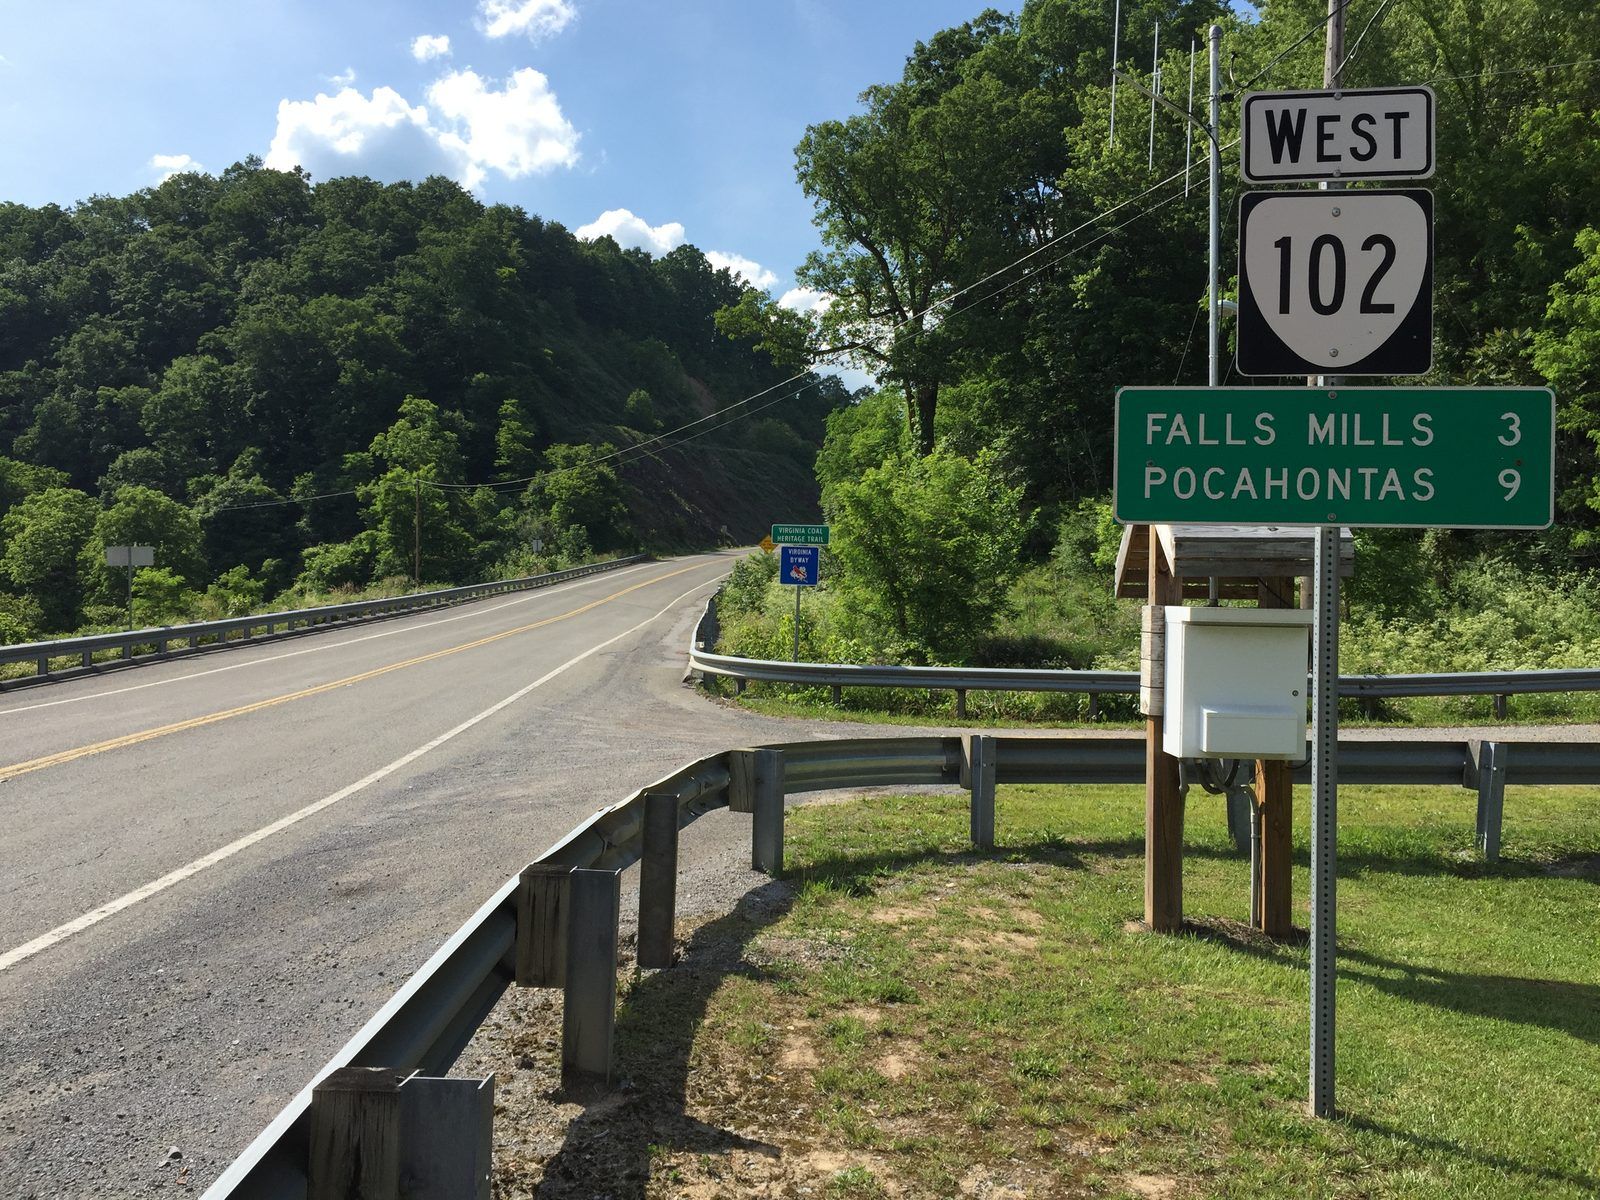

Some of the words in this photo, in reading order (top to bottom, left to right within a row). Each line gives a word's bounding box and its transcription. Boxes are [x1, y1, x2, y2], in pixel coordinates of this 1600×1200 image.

[1264, 108, 1410, 165] WEST
[1273, 233, 1397, 316] 102
[1146, 412, 1277, 446] FALLS
[1308, 412, 1435, 447] MILLS
[1498, 412, 1522, 447] 3
[1144, 466, 1436, 501] POCAHONTAS
[1498, 468, 1522, 501] 9
